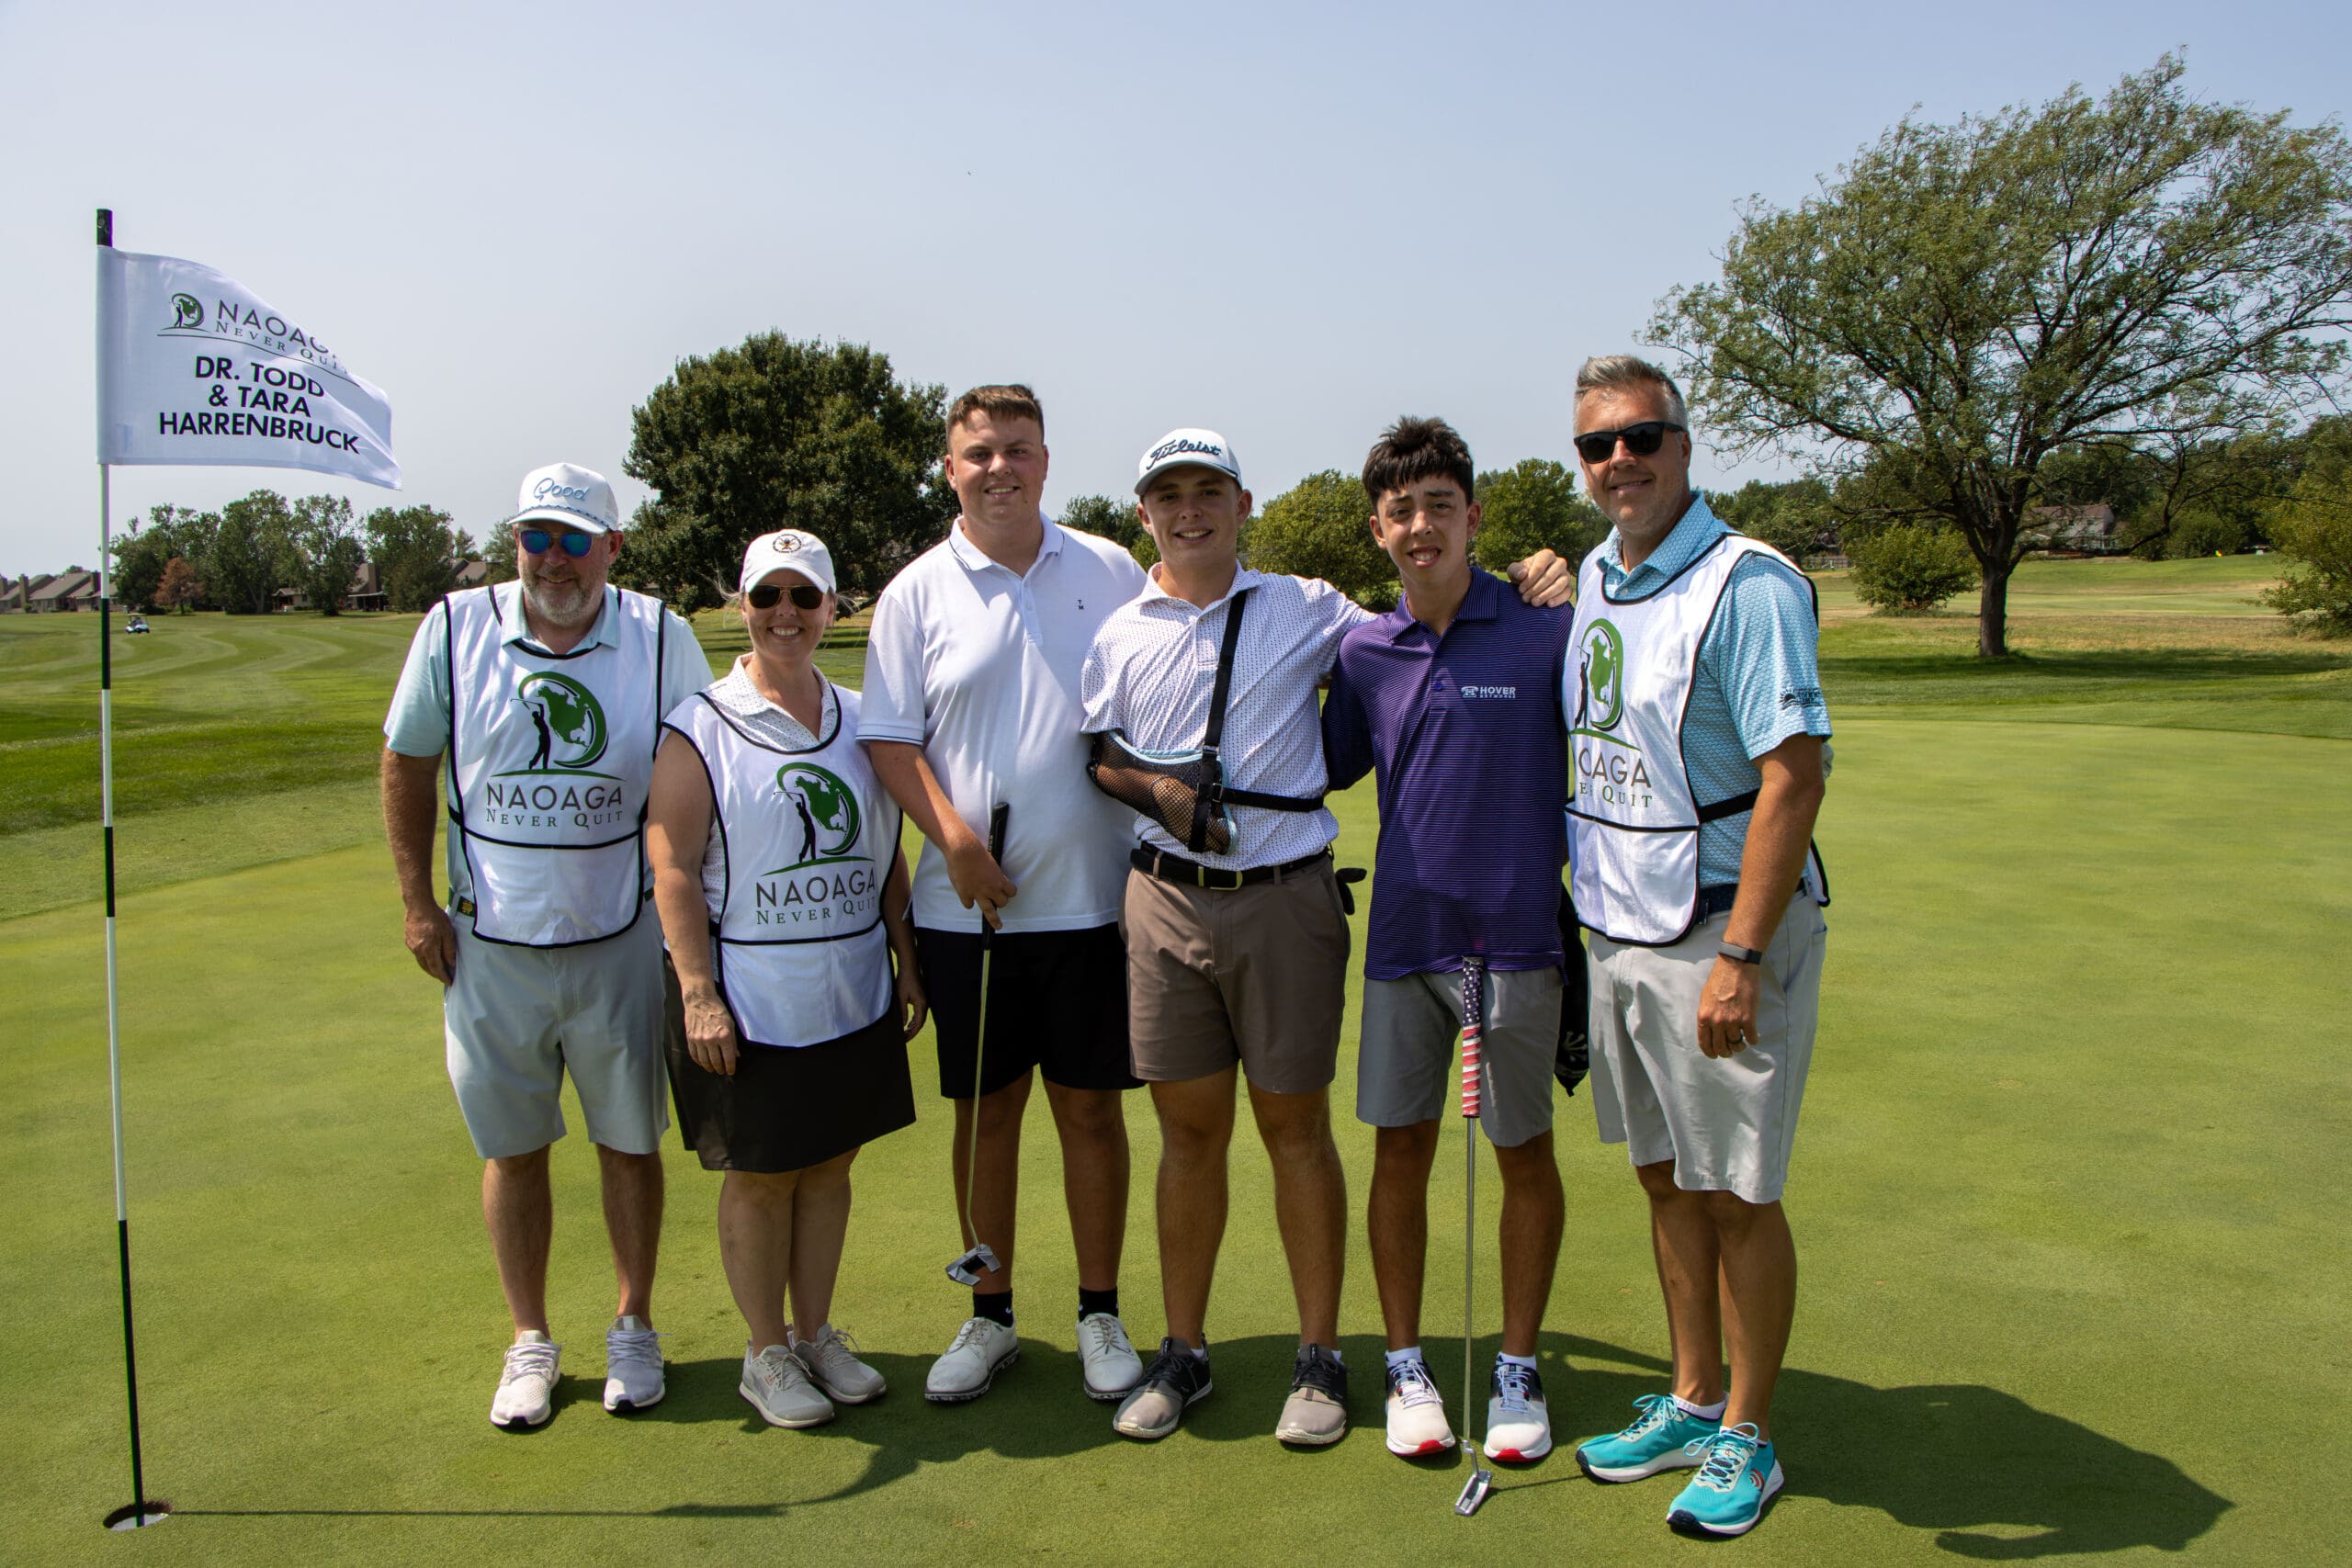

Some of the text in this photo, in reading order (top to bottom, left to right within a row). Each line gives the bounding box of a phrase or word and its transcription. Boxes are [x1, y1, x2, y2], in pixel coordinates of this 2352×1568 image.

[216, 321, 286, 352] NEVER
[218, 299, 337, 358] NAOAG
[196, 355, 324, 397] DR. TODD
[209, 384, 311, 417] & TARA
[159, 412, 360, 454] HARRENBRUCK
[1146, 439, 1221, 469] Titleist
[1479, 686, 1516, 694] HOVER
[486, 782, 622, 811] NAOAGA
[1602, 785, 1653, 808] QUIT
[486, 810, 624, 830] NEVER QUIT
[755, 866, 876, 908] NAOAGA
[756, 908, 831, 924] NEVER
